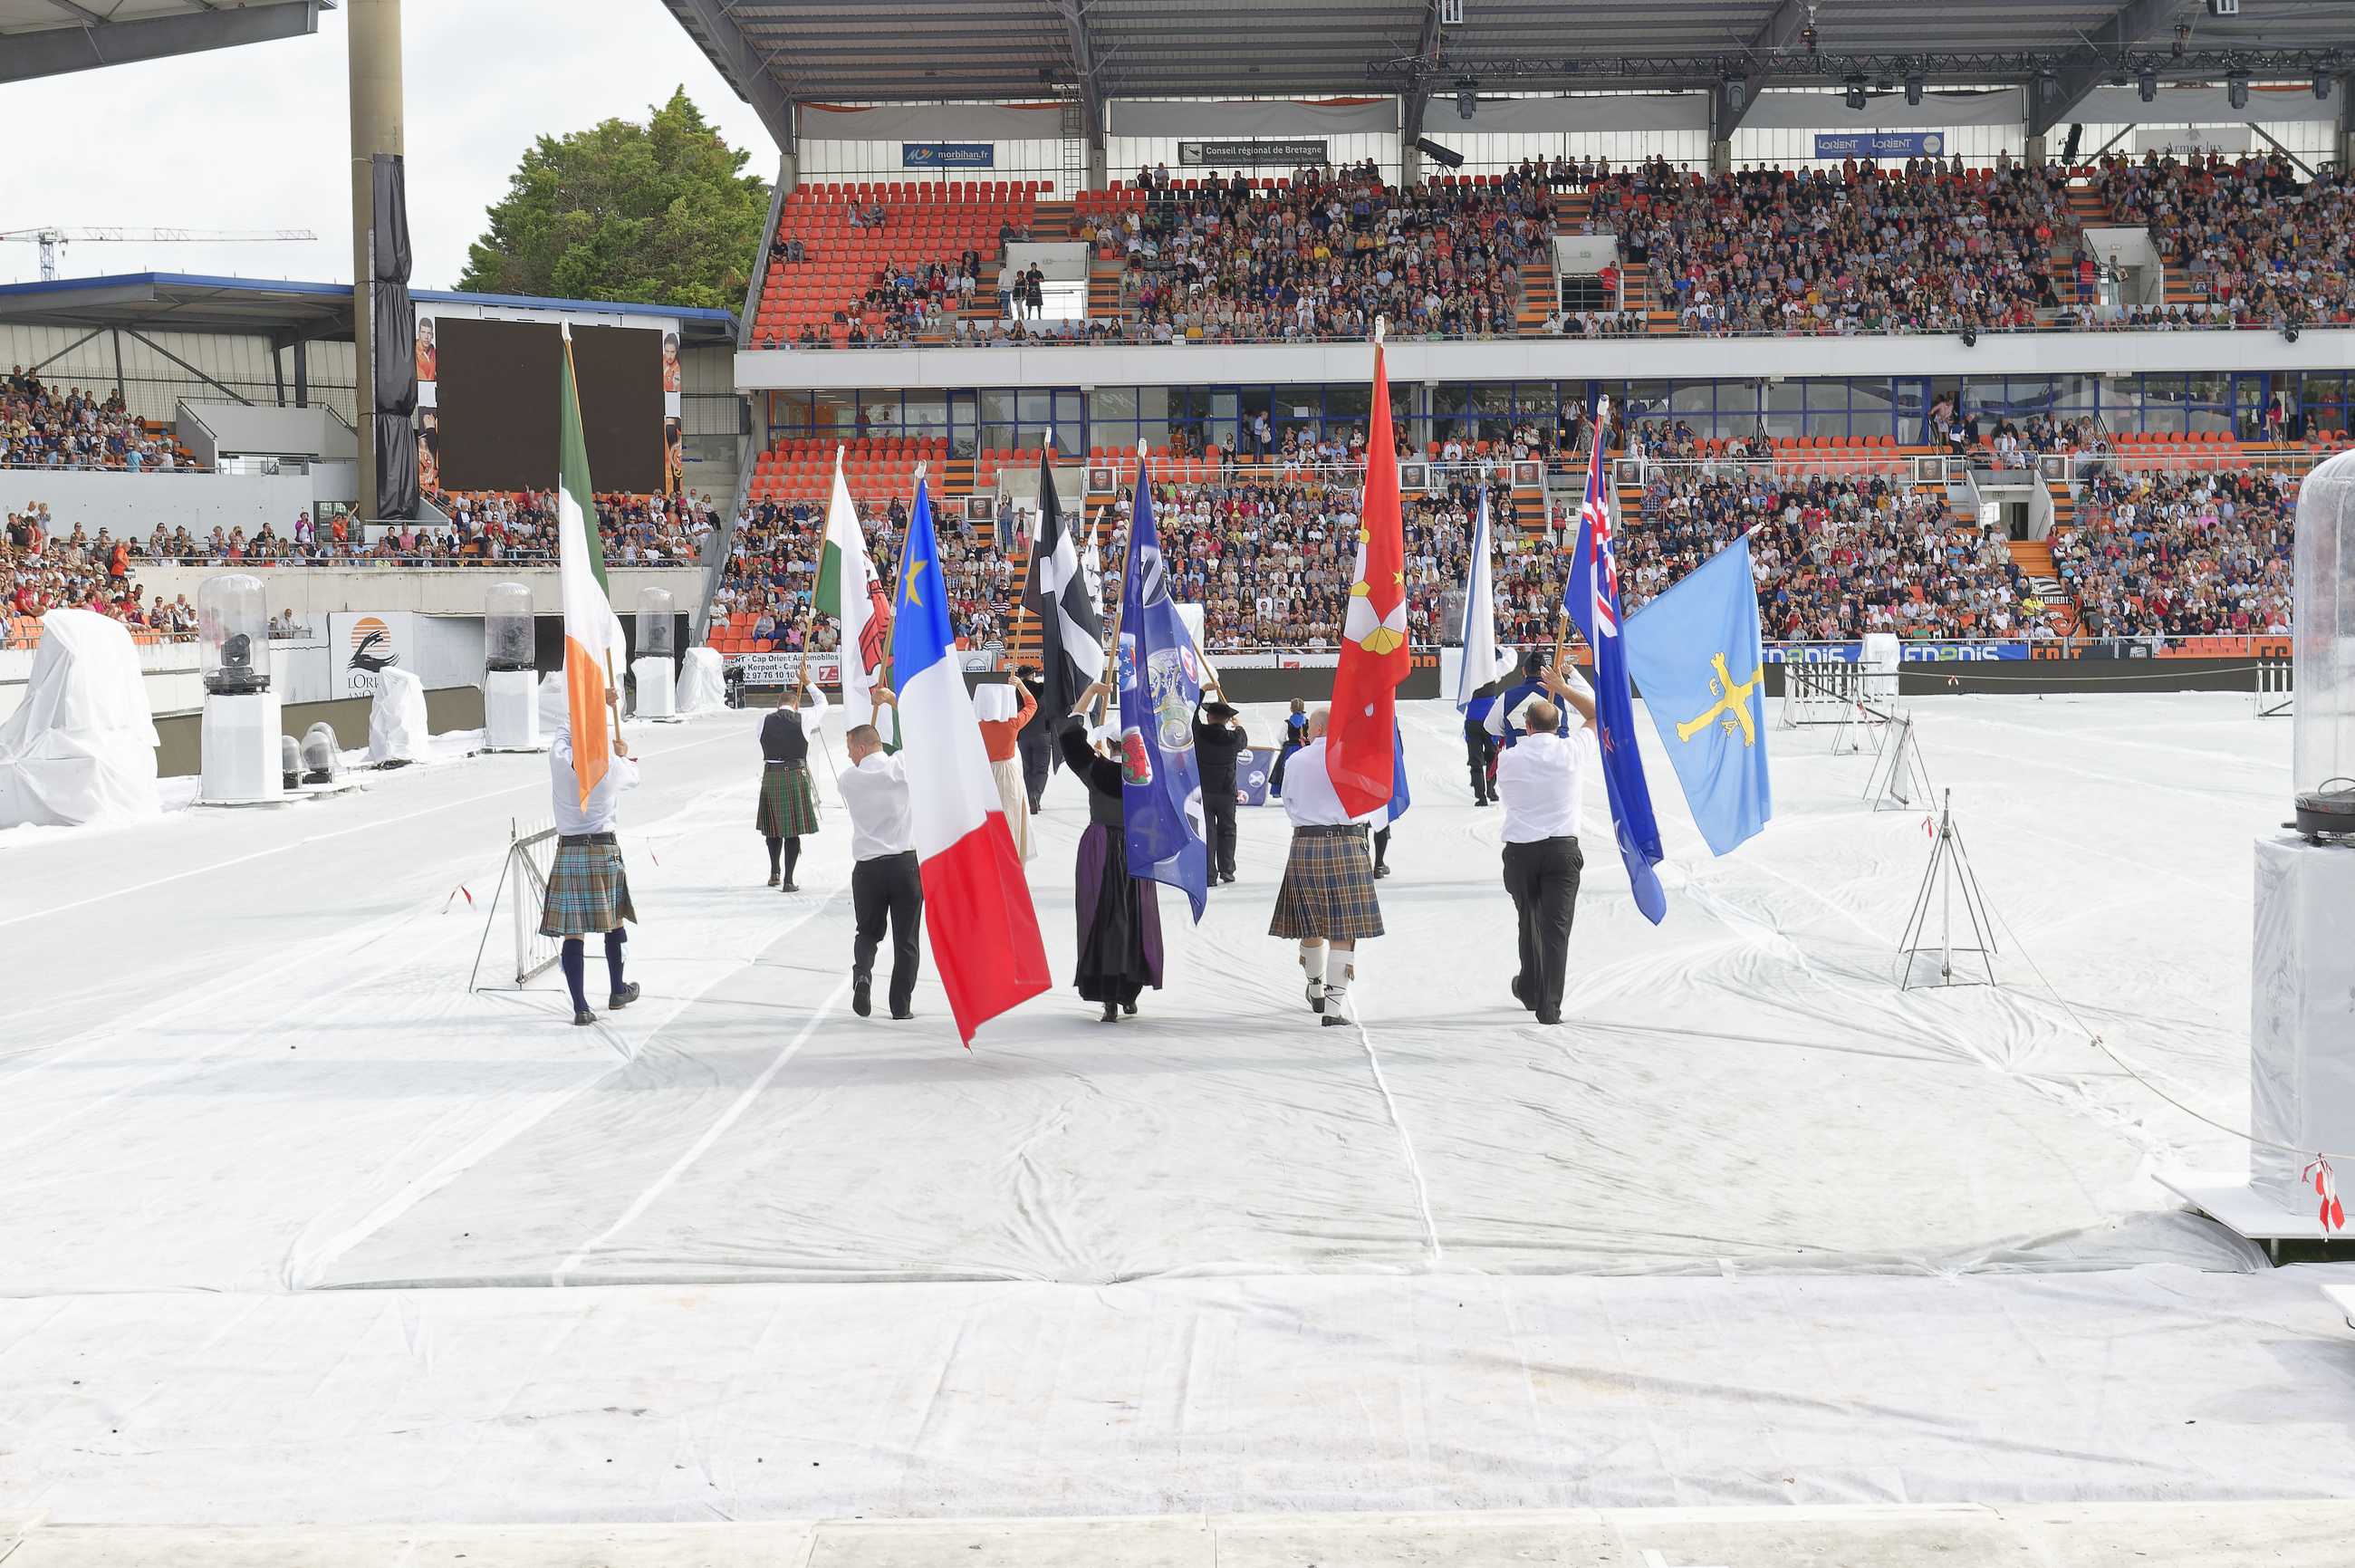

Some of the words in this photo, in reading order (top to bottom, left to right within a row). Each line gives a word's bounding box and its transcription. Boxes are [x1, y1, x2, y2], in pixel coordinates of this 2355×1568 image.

[1819, 139, 1859, 149] LORIENT
[1872, 138, 1912, 149] LORIENT
[937, 149, 989, 159] morbihan.fr
[1206, 146, 1235, 155] Conseil
[1238, 145, 1271, 157] régional
[1273, 146, 1283, 154] de
[1285, 145, 1322, 156] Bretagne
[752, 655, 766, 665] Cap
[768, 654, 791, 662] Orient
[793, 653, 839, 662] Auomobiles
[747, 663, 777, 673] Kerpont
